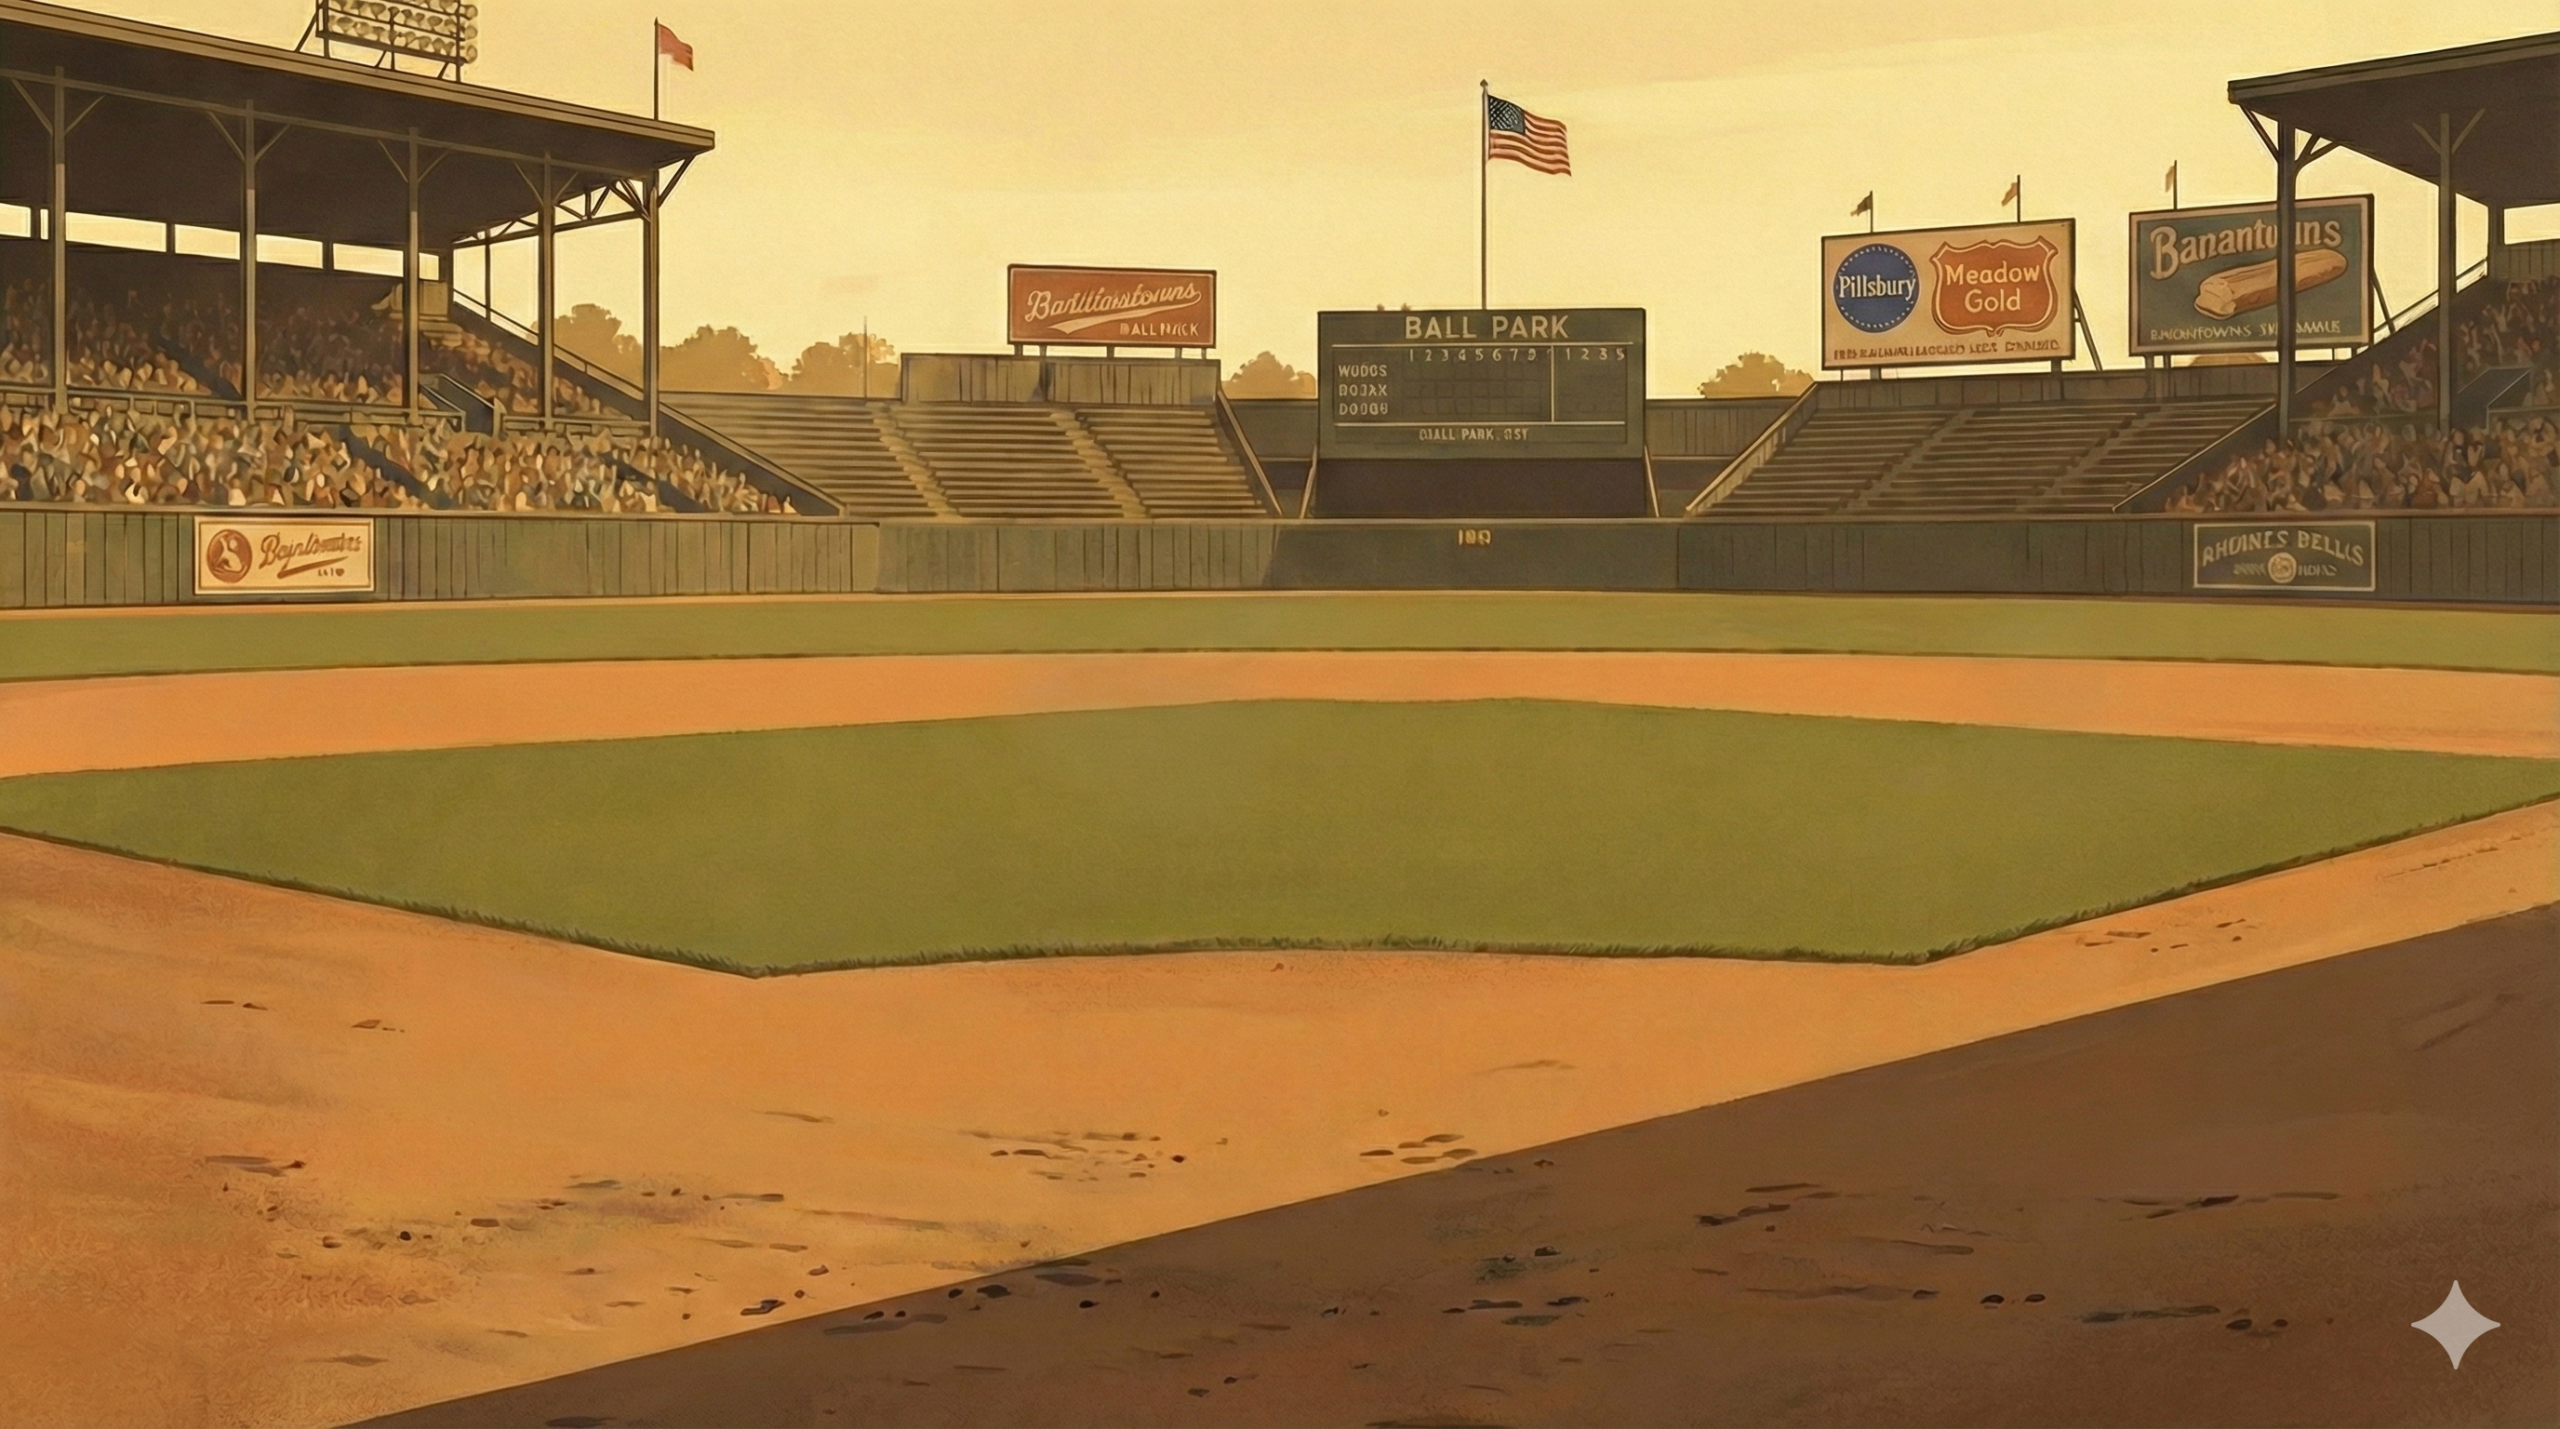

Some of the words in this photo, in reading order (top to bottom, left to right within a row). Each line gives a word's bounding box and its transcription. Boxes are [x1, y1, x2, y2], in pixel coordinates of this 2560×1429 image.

[1944, 260, 2041, 286] Meadow
[1838, 273, 1917, 301] Pillsbury
[1964, 287, 2021, 313] Gold
[1405, 315, 1477, 339] BALL
[1492, 315, 1569, 339] PARK
[1425, 348, 1433, 362] 2
[1492, 348, 1502, 362] 6
[1509, 348, 1519, 362] 7
[1565, 347, 1571, 361] 1
[1581, 347, 1590, 361] 2
